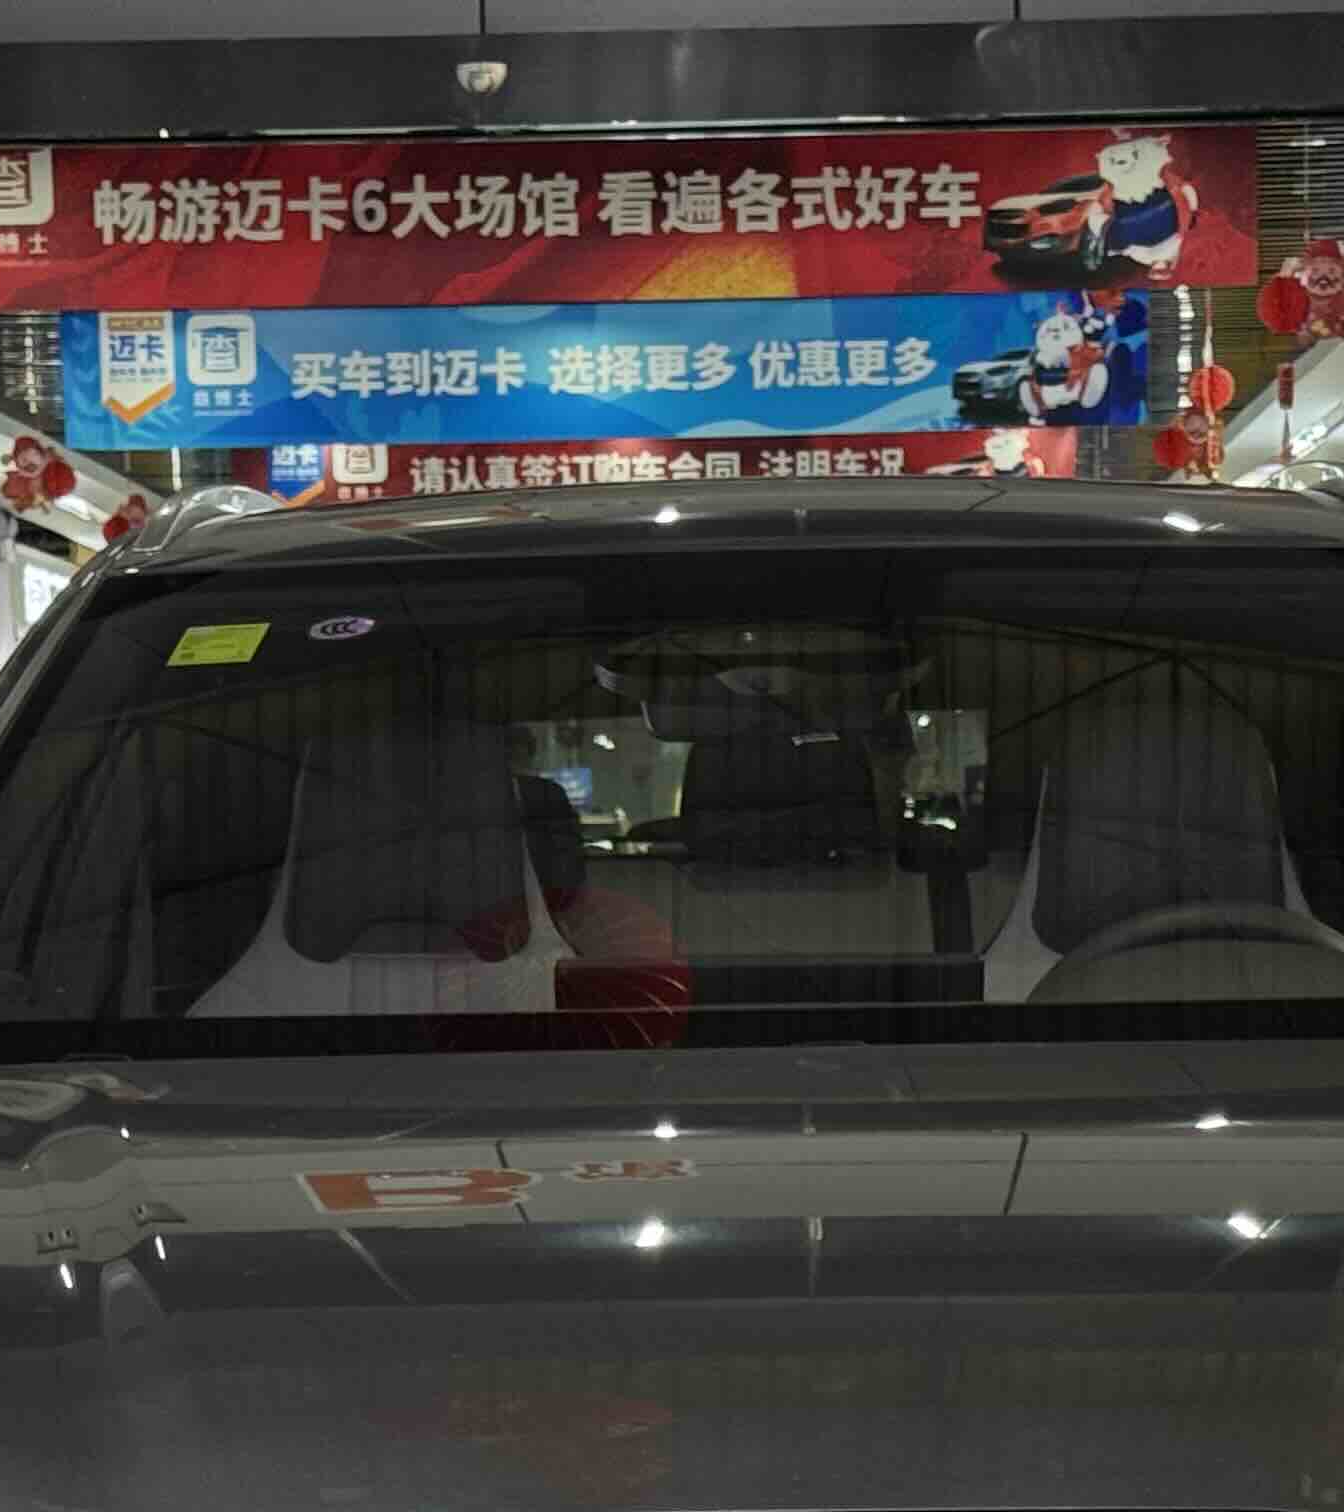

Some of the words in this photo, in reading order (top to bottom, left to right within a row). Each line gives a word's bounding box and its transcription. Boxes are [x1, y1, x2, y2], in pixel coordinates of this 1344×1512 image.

[93, 172, 579, 247] 畅游迈卡6大场馆
[598, 164, 982, 236] 看遍各式好车
[109, 335, 165, 362] 迈卡
[290, 349, 528, 400] 买车到迈卡
[548, 342, 737, 395] 选择更多
[748, 337, 939, 390] 优惠更多
[410, 451, 742, 495] 请认真签订购车合同
